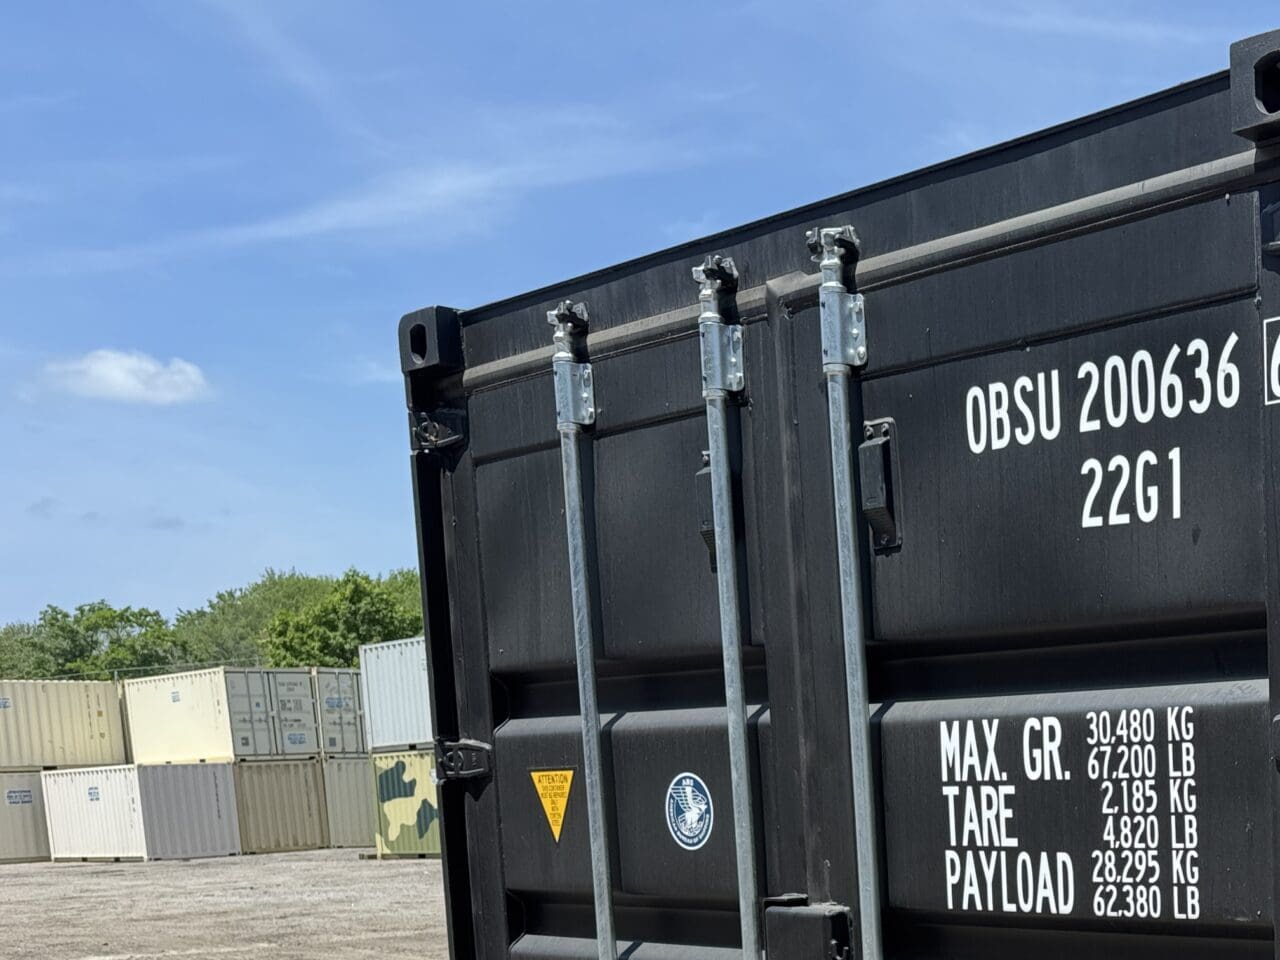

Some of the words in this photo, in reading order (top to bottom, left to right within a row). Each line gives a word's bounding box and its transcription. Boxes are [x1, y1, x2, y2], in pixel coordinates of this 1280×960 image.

[965, 369, 1061, 454] OBSU
[1077, 331, 1240, 433] 200636
[1080, 447, 1181, 528] 22G1
[940, 718, 1007, 782] MAX.
[1023, 716, 1070, 780] GR.
[1086, 708, 1155, 745] 30,480
[1167, 706, 1194, 741] KG
[1087, 744, 1156, 780] 67,200
[1168, 743, 1195, 777] LB
[538, 773, 568, 784] ATTENTION
[942, 785, 1018, 847] TARE
[1101, 780, 1157, 814] 2,185
[1169, 778, 1196, 813] KG
[1103, 815, 1158, 849] 4,820
[1171, 815, 1198, 849] LB
[945, 850, 1074, 914] PAYLOAD
[1091, 850, 1160, 883] 28,295
[1172, 850, 1199, 884] KG
[1093, 885, 1161, 918] 62,380
[1173, 886, 1199, 919] LB
